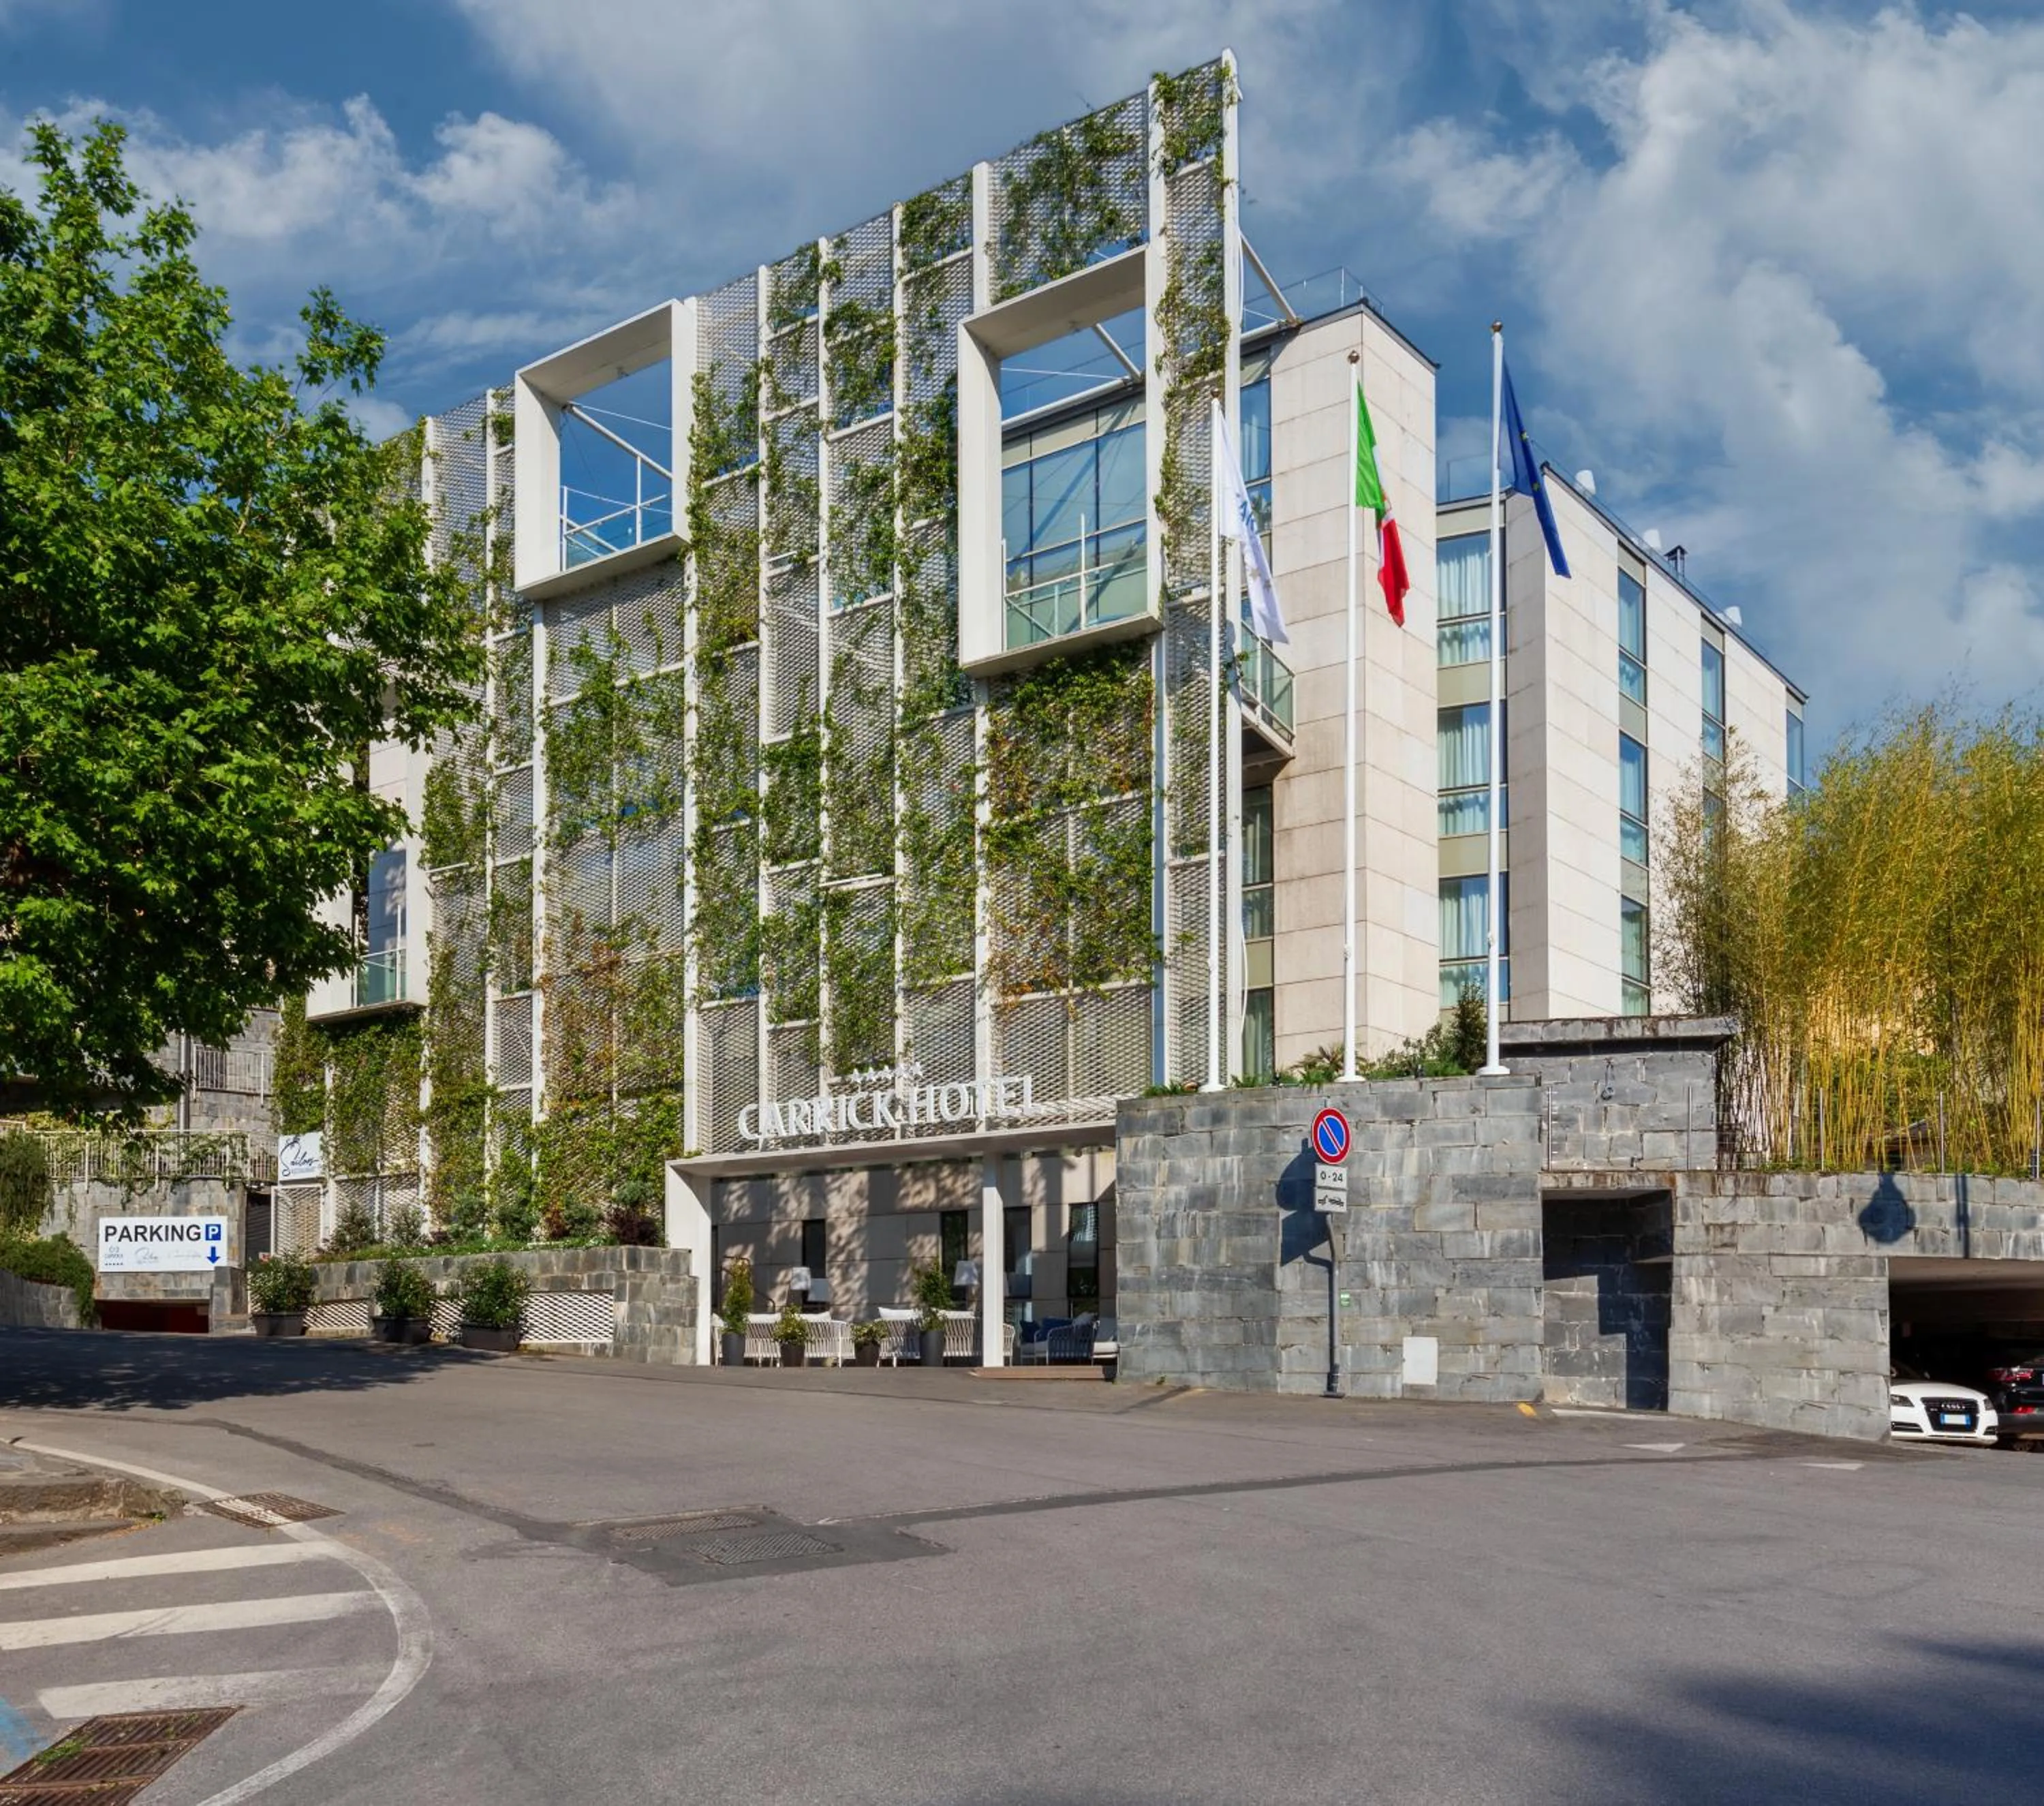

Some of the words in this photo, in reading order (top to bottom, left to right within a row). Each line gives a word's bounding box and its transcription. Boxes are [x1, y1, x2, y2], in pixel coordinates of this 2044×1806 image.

[738, 1090, 898, 1139] CARRICK
[908, 1075, 1044, 1124] HOTEL
[104, 1224, 201, 1242] PARKING
[208, 1225, 219, 1240] P
